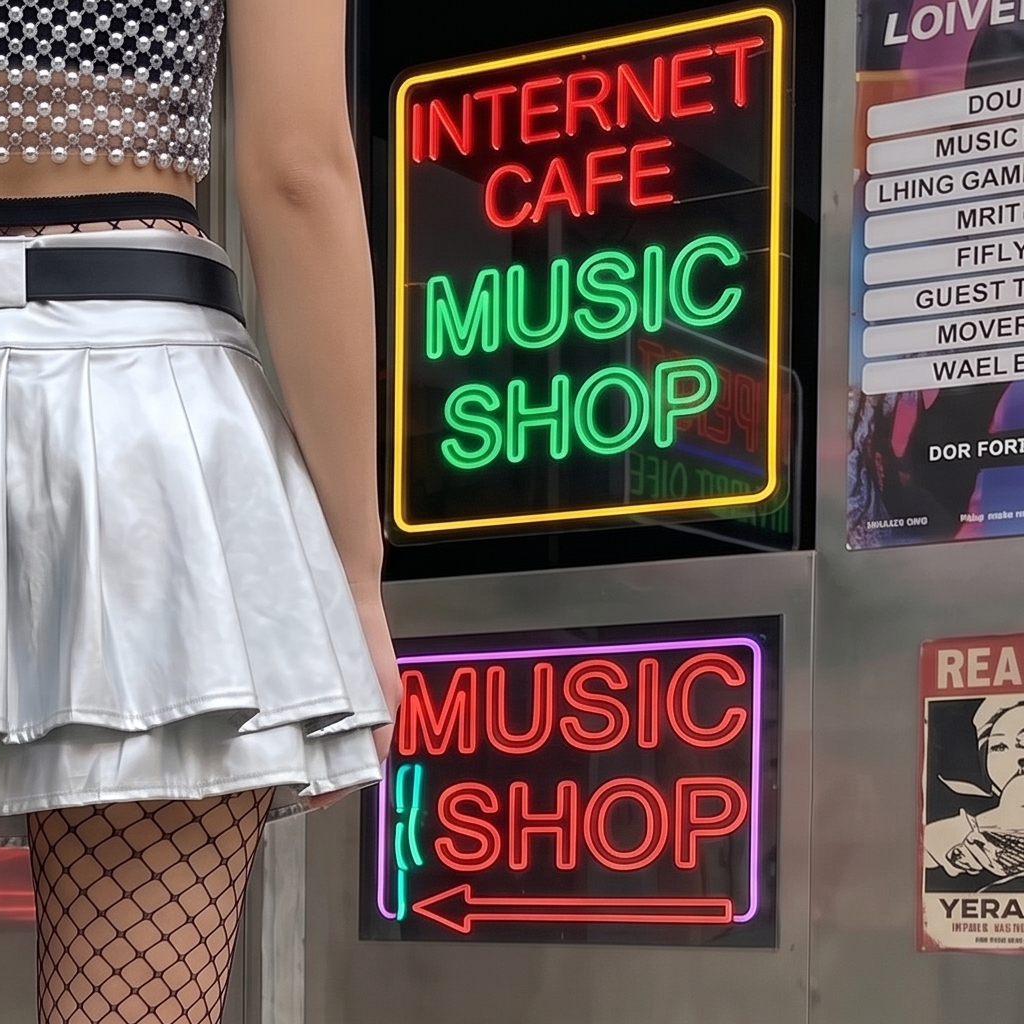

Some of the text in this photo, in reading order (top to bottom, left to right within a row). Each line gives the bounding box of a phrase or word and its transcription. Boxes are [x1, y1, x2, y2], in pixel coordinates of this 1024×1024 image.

[884, 0, 1024, 46] LOIVE
[413, 36, 764, 164] INTERNET
[968, 88, 1022, 115] DOU
[936, 128, 1018, 158] MUSIC
[484, 138, 674, 228] CAFE
[879, 164, 1024, 203] LHING GAM
[957, 202, 1024, 230] MRIT
[426, 234, 743, 360] MUSIC
[916, 279, 1006, 310] GUEST
[933, 355, 1007, 381] WAEL
[440, 358, 719, 470] SHOP
[929, 442, 972, 462] DOR
[936, 646, 1023, 690] REA
[398, 652, 748, 757] MUSIC
[434, 776, 749, 872] SHOP
[939, 898, 1024, 919] YERA
